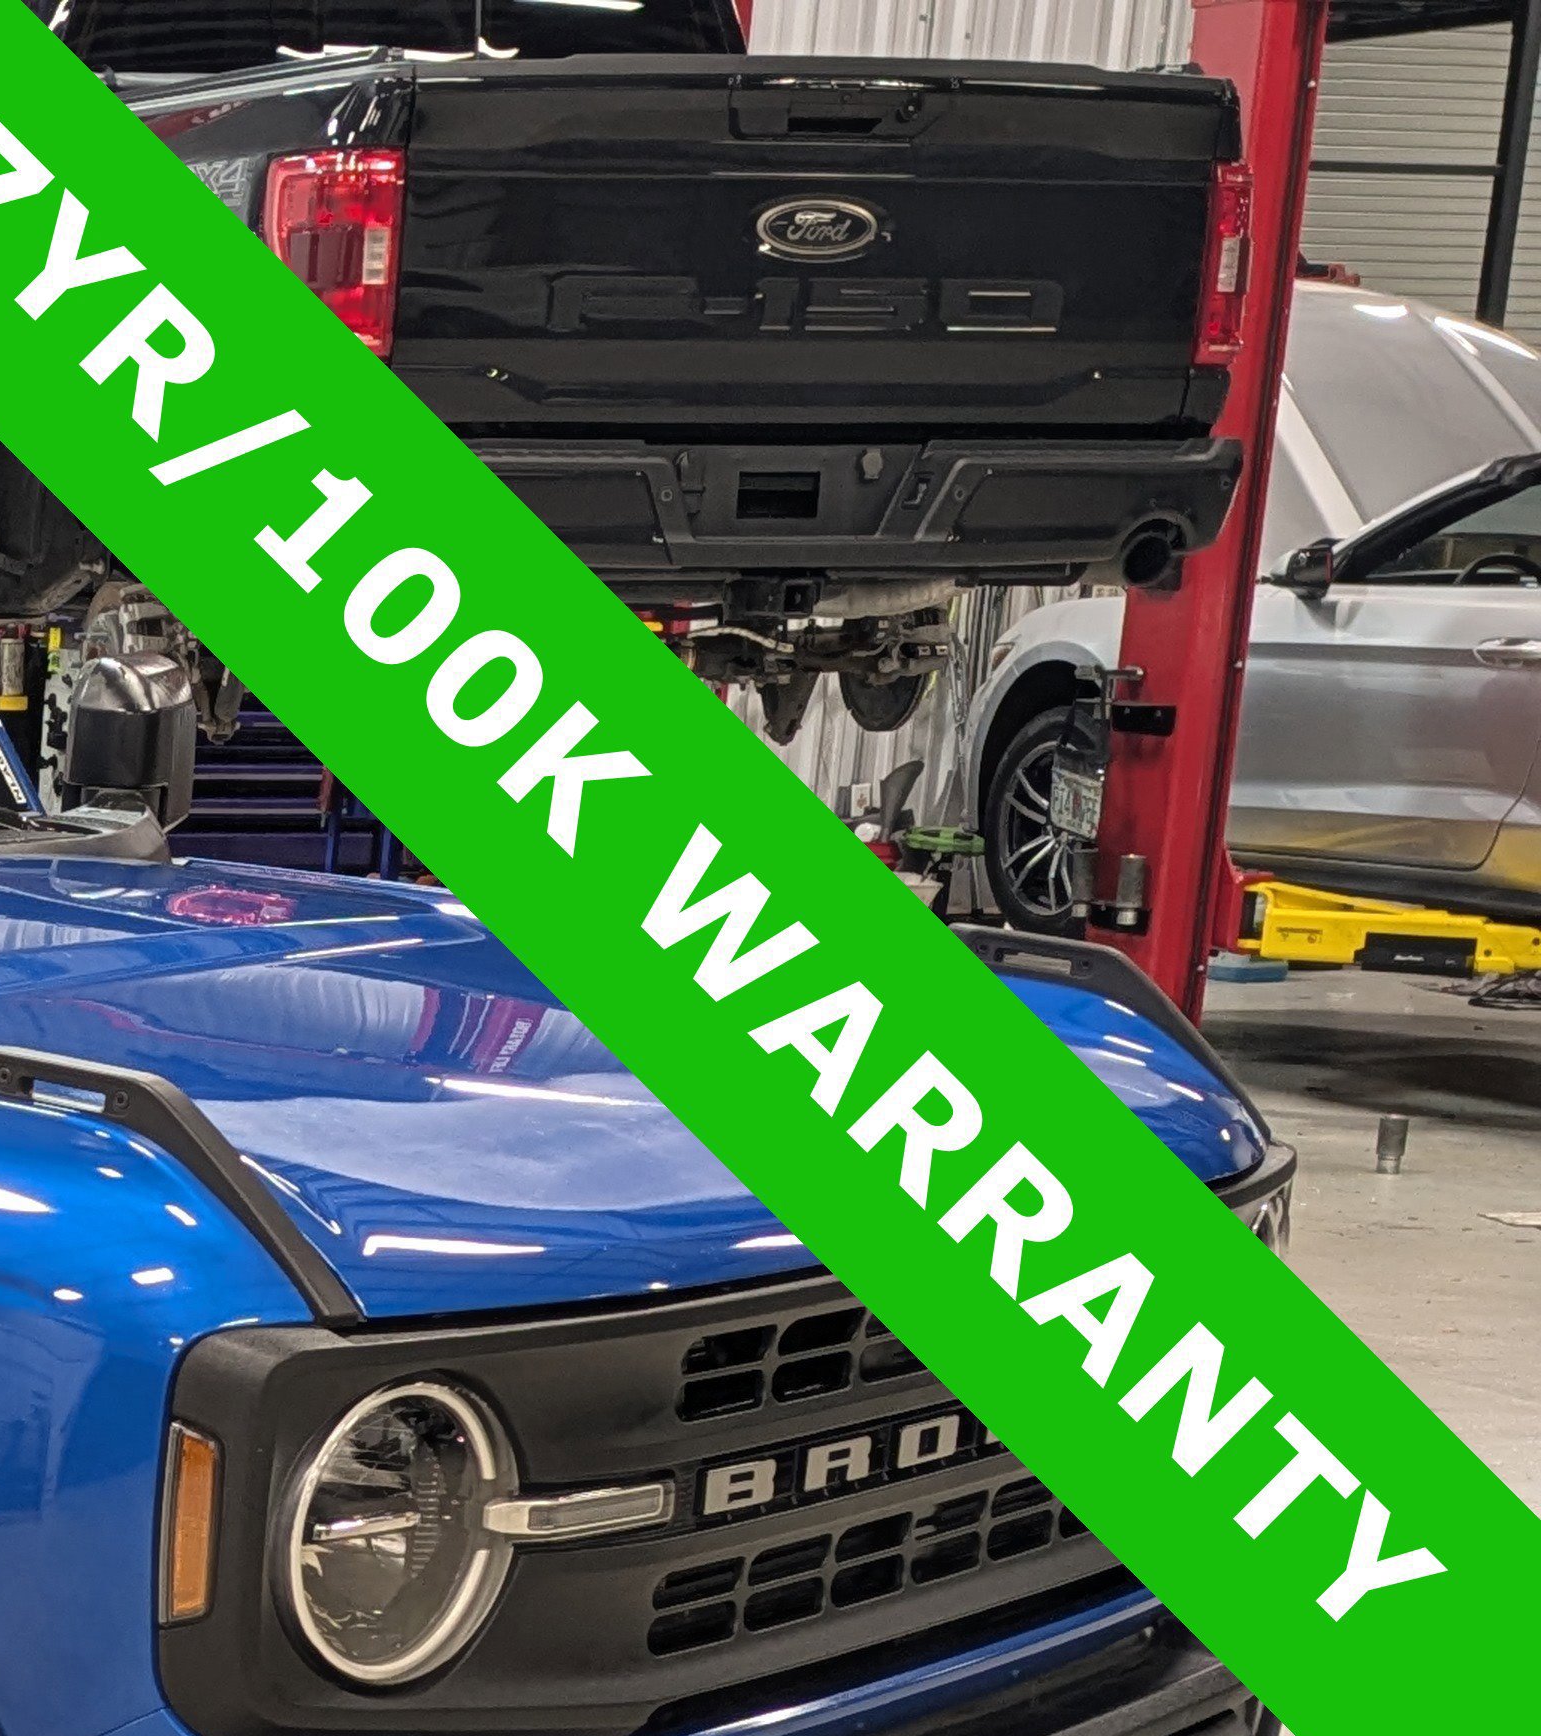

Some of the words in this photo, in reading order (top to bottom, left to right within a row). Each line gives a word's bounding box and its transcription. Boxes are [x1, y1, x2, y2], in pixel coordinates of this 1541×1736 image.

[786, 211, 852, 242] Ford
[549, 274, 1064, 332] F-150
[703, 1414, 1005, 1516] BRO
